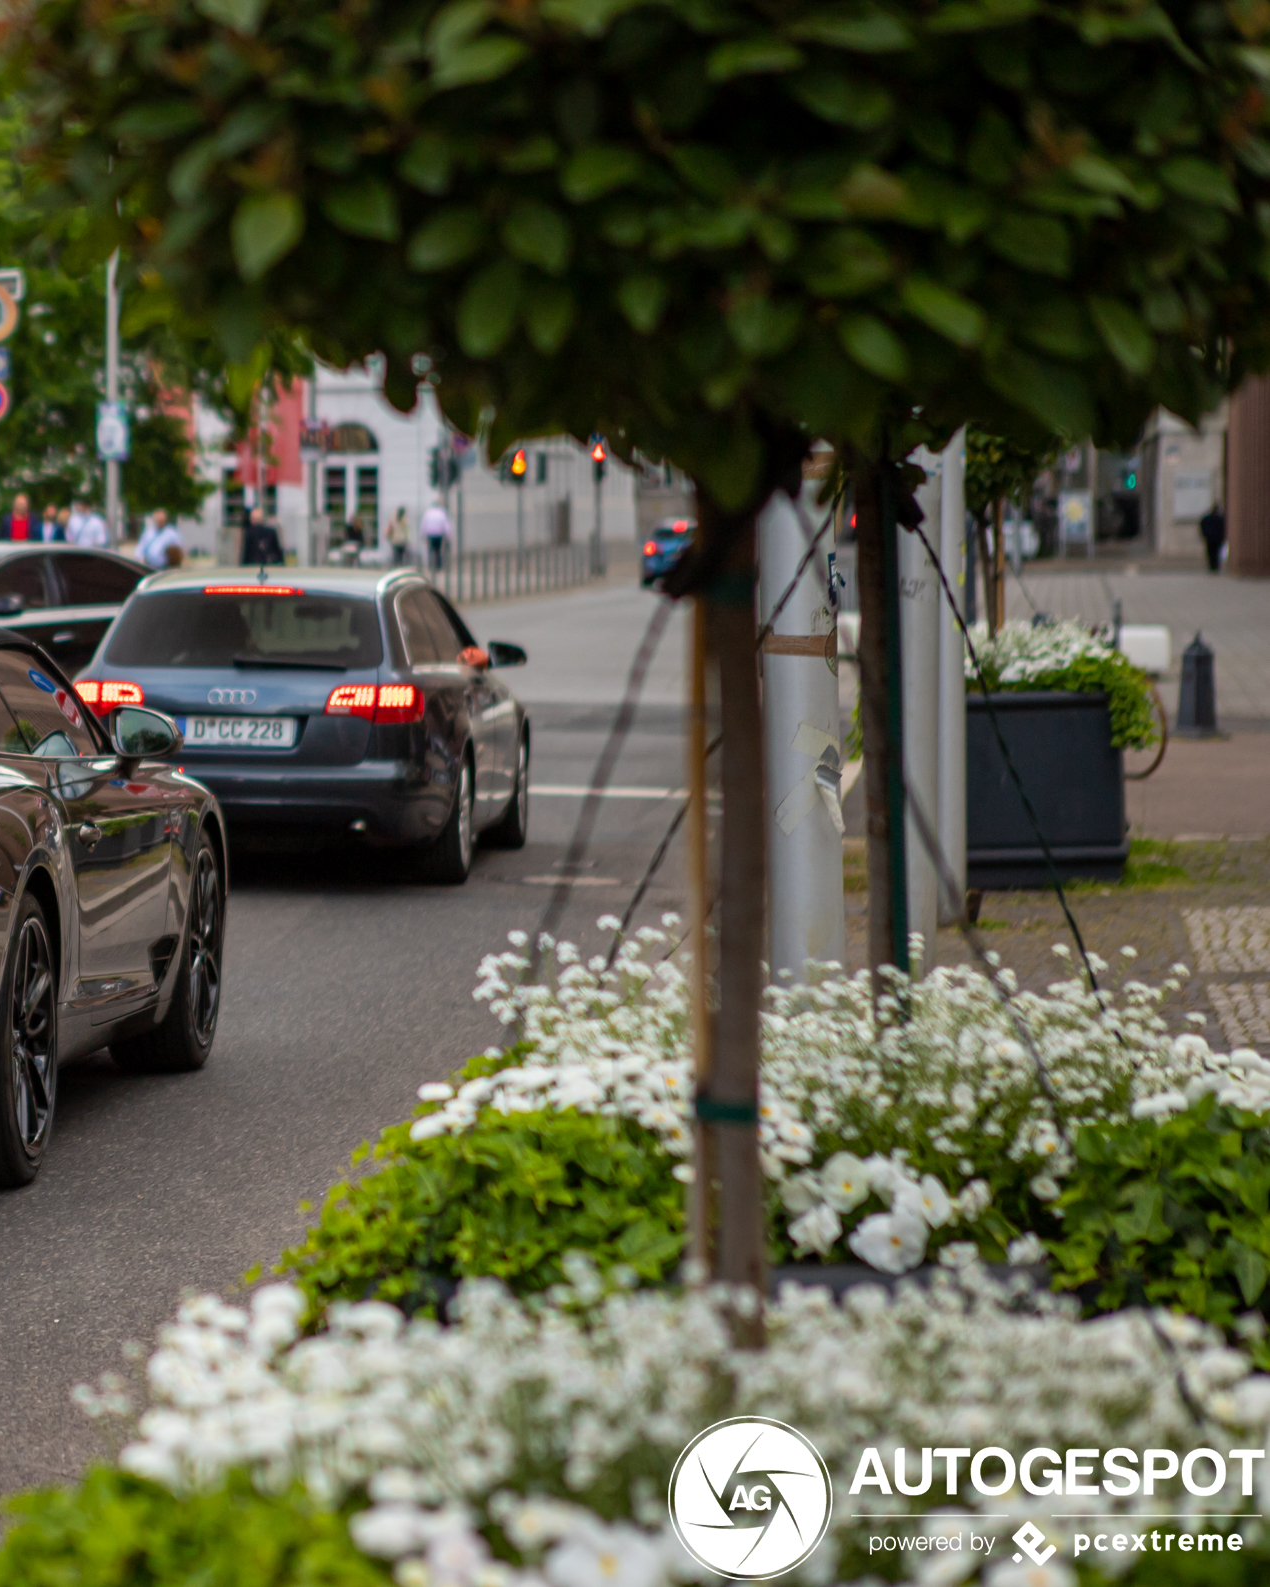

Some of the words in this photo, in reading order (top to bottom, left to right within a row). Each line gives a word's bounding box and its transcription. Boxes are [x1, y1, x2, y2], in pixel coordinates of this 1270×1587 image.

[194, 720, 205, 738] D
[218, 720, 243, 739] CC
[247, 721, 283, 740] 228
